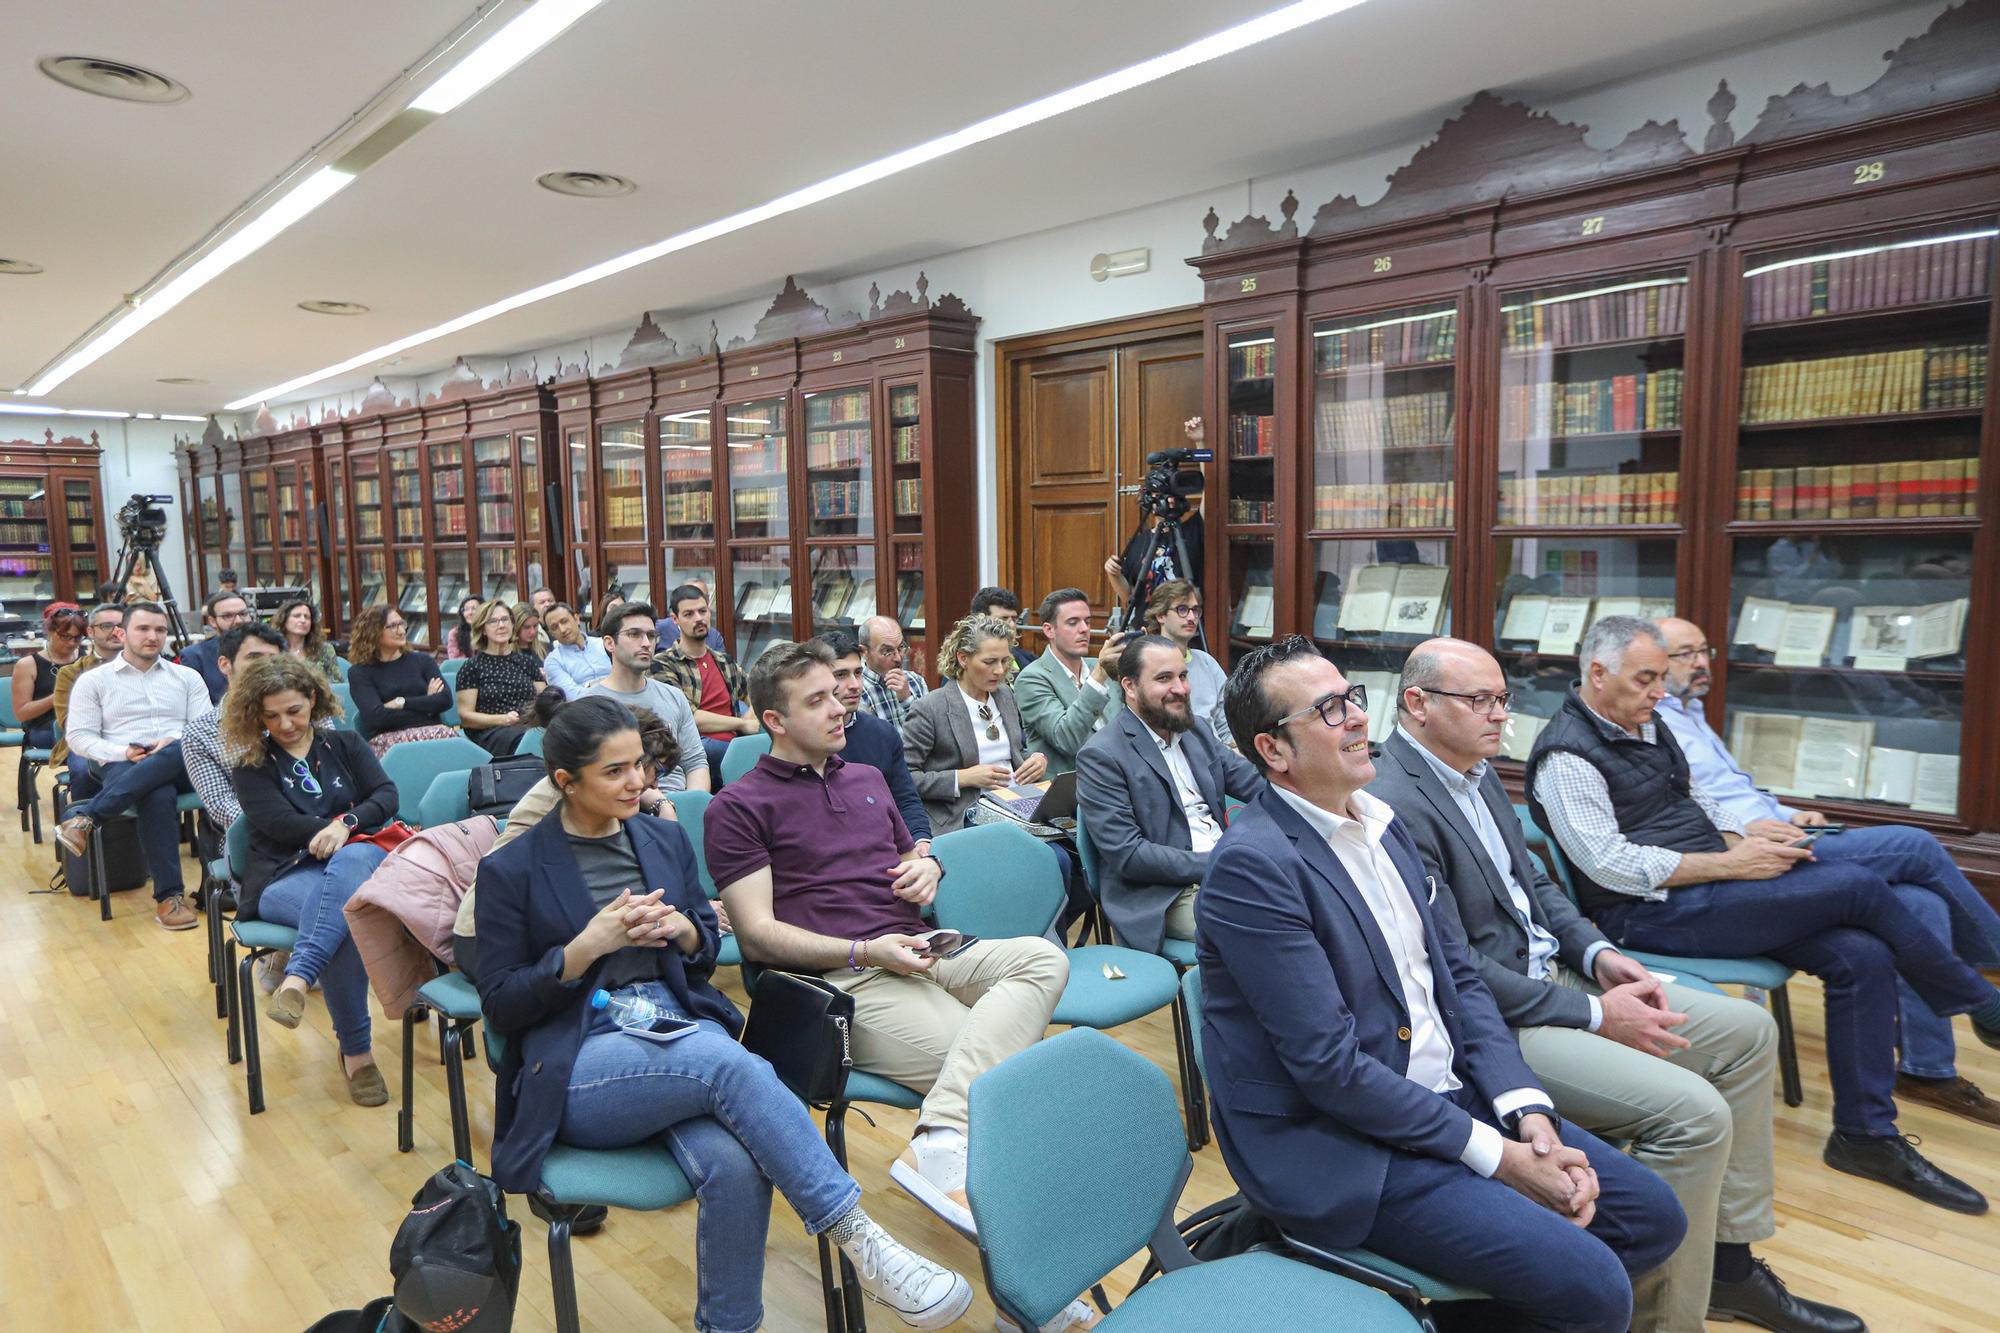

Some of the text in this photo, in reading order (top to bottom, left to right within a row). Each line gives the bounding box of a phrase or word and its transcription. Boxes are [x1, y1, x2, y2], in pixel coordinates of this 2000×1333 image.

[1853, 161, 1884, 185] 28
[1582, 216, 1605, 236] 27
[1373, 256, 1392, 273] 26
[1241, 278, 1256, 292] 25
[895, 337, 905, 349] 24
[832, 351, 842, 362] 23
